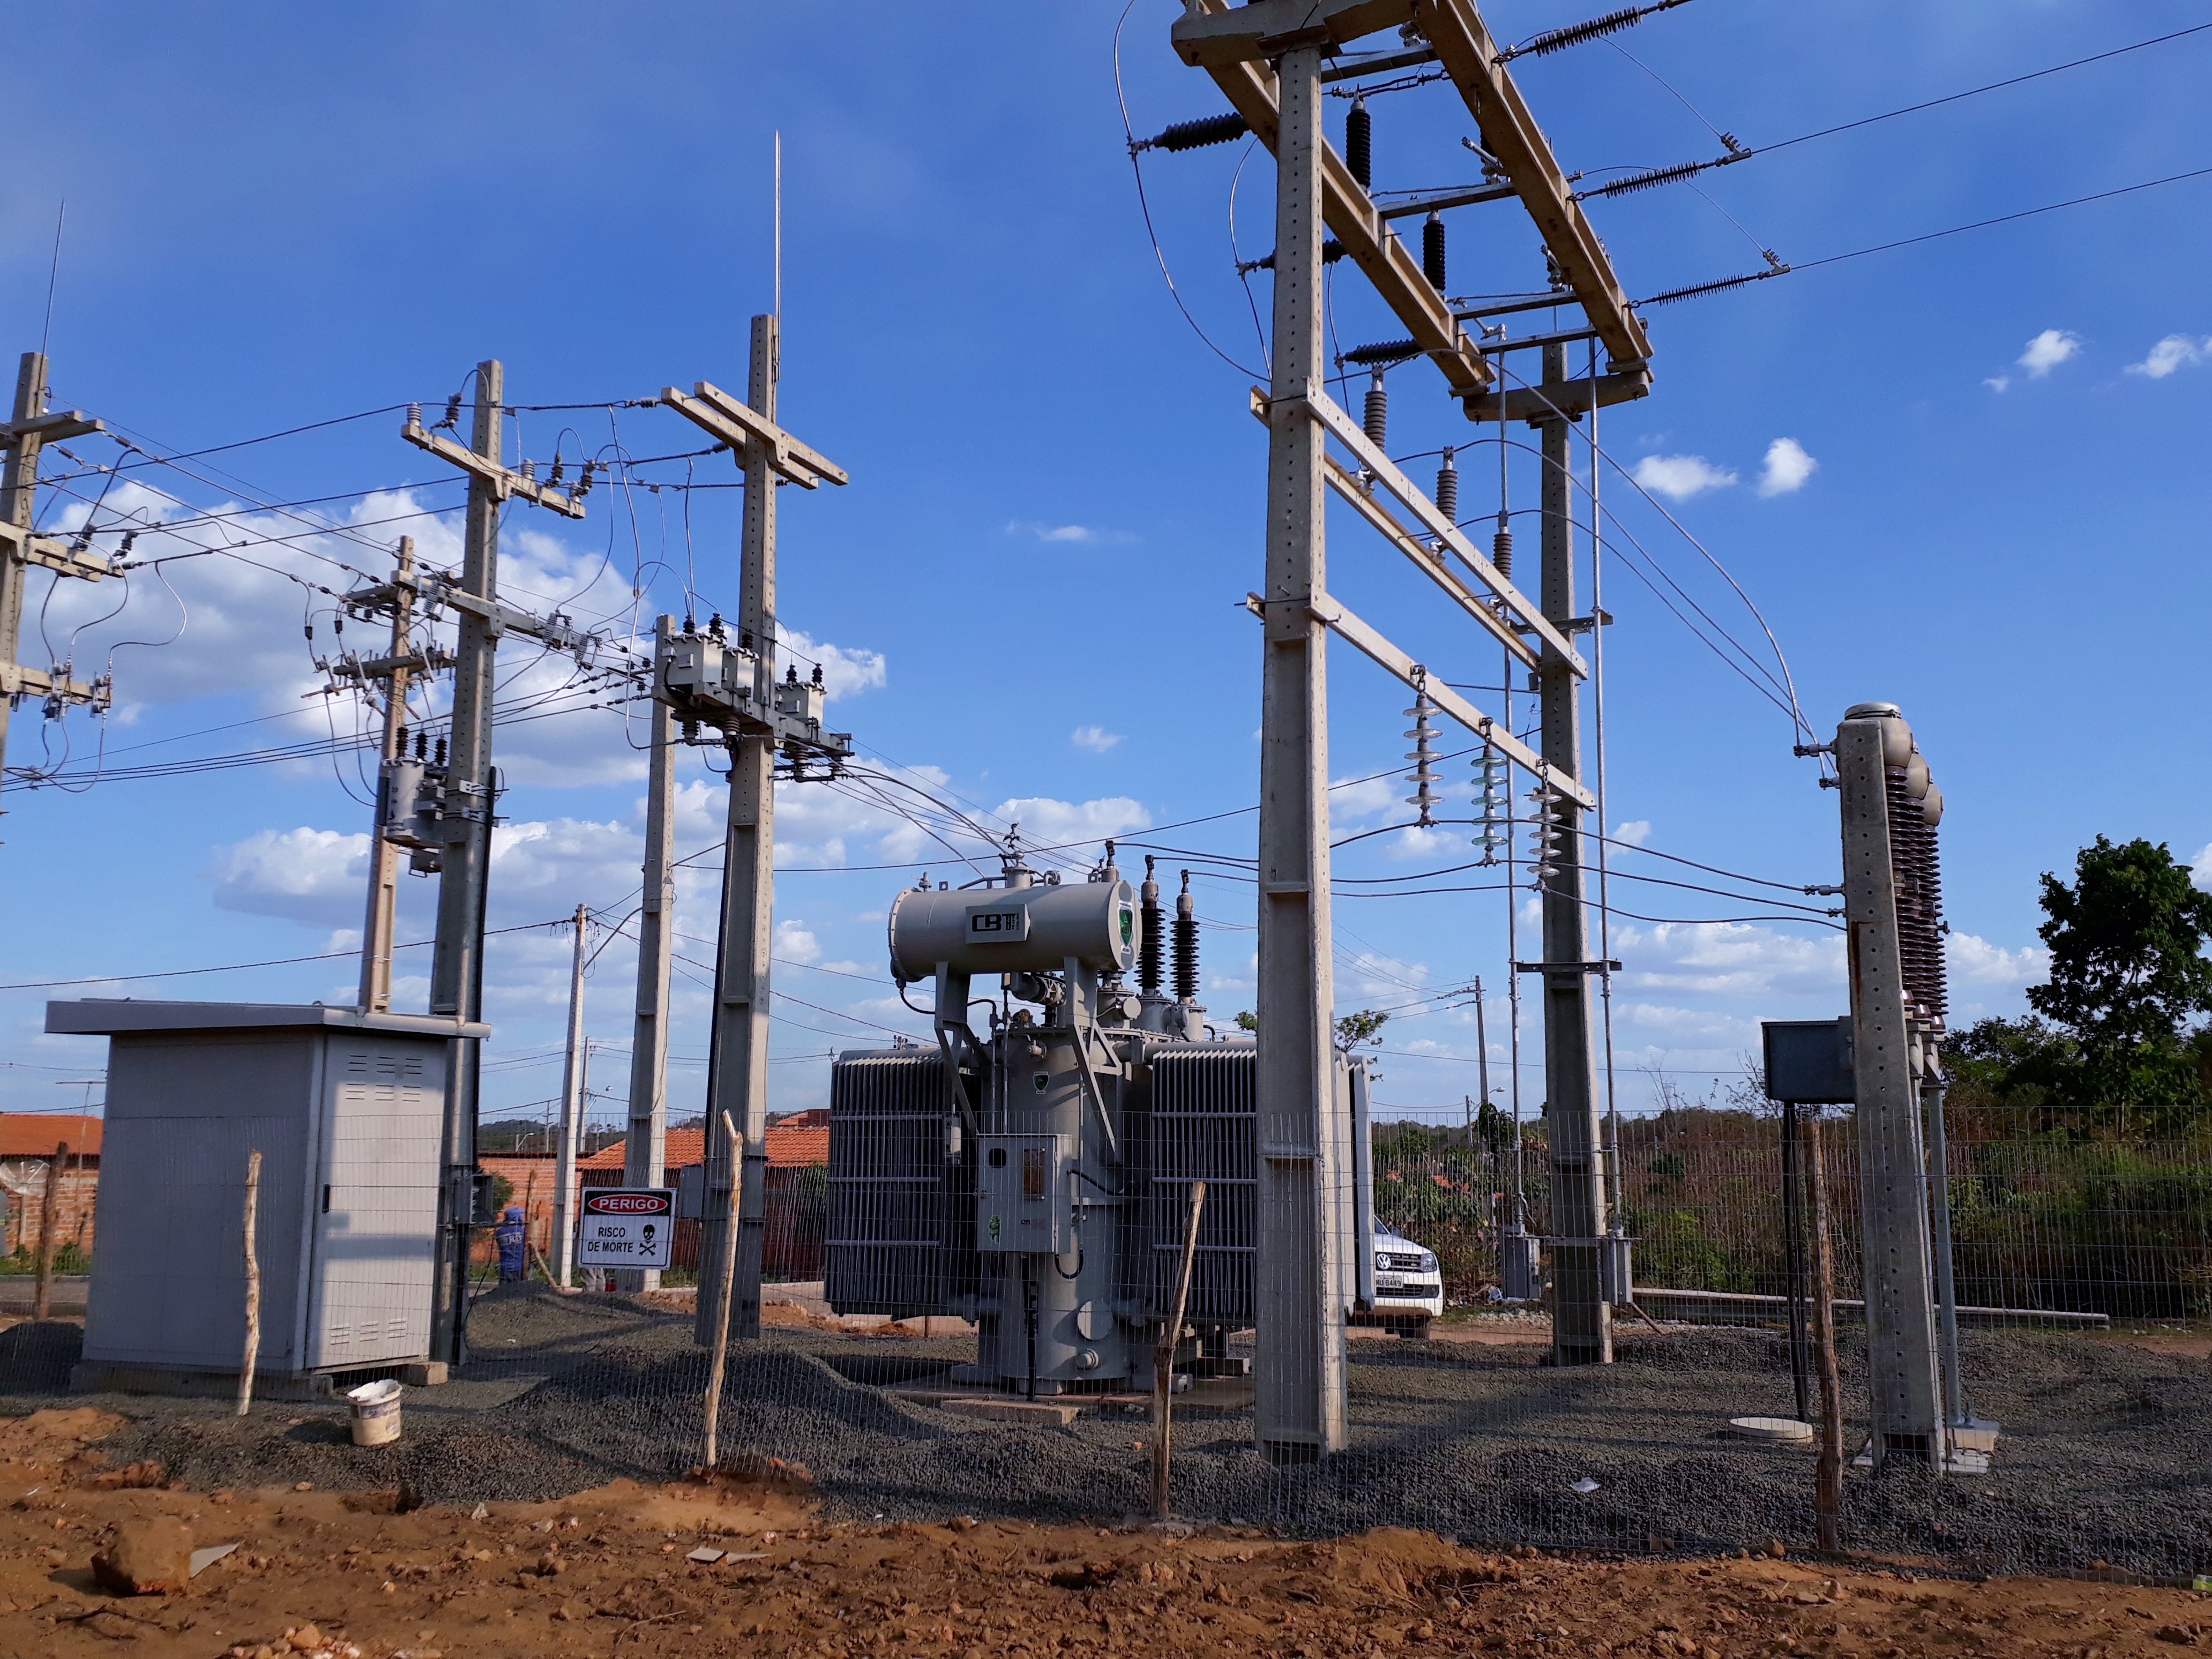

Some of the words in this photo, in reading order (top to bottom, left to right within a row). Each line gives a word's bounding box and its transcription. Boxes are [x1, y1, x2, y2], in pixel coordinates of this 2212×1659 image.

[972, 913, 1016, 932] CBT
[600, 1199, 658, 1209] PERIGO
[599, 1227, 625, 1237] RISCO
[588, 1242, 600, 1252] DE
[602, 1242, 633, 1252] MORTE
